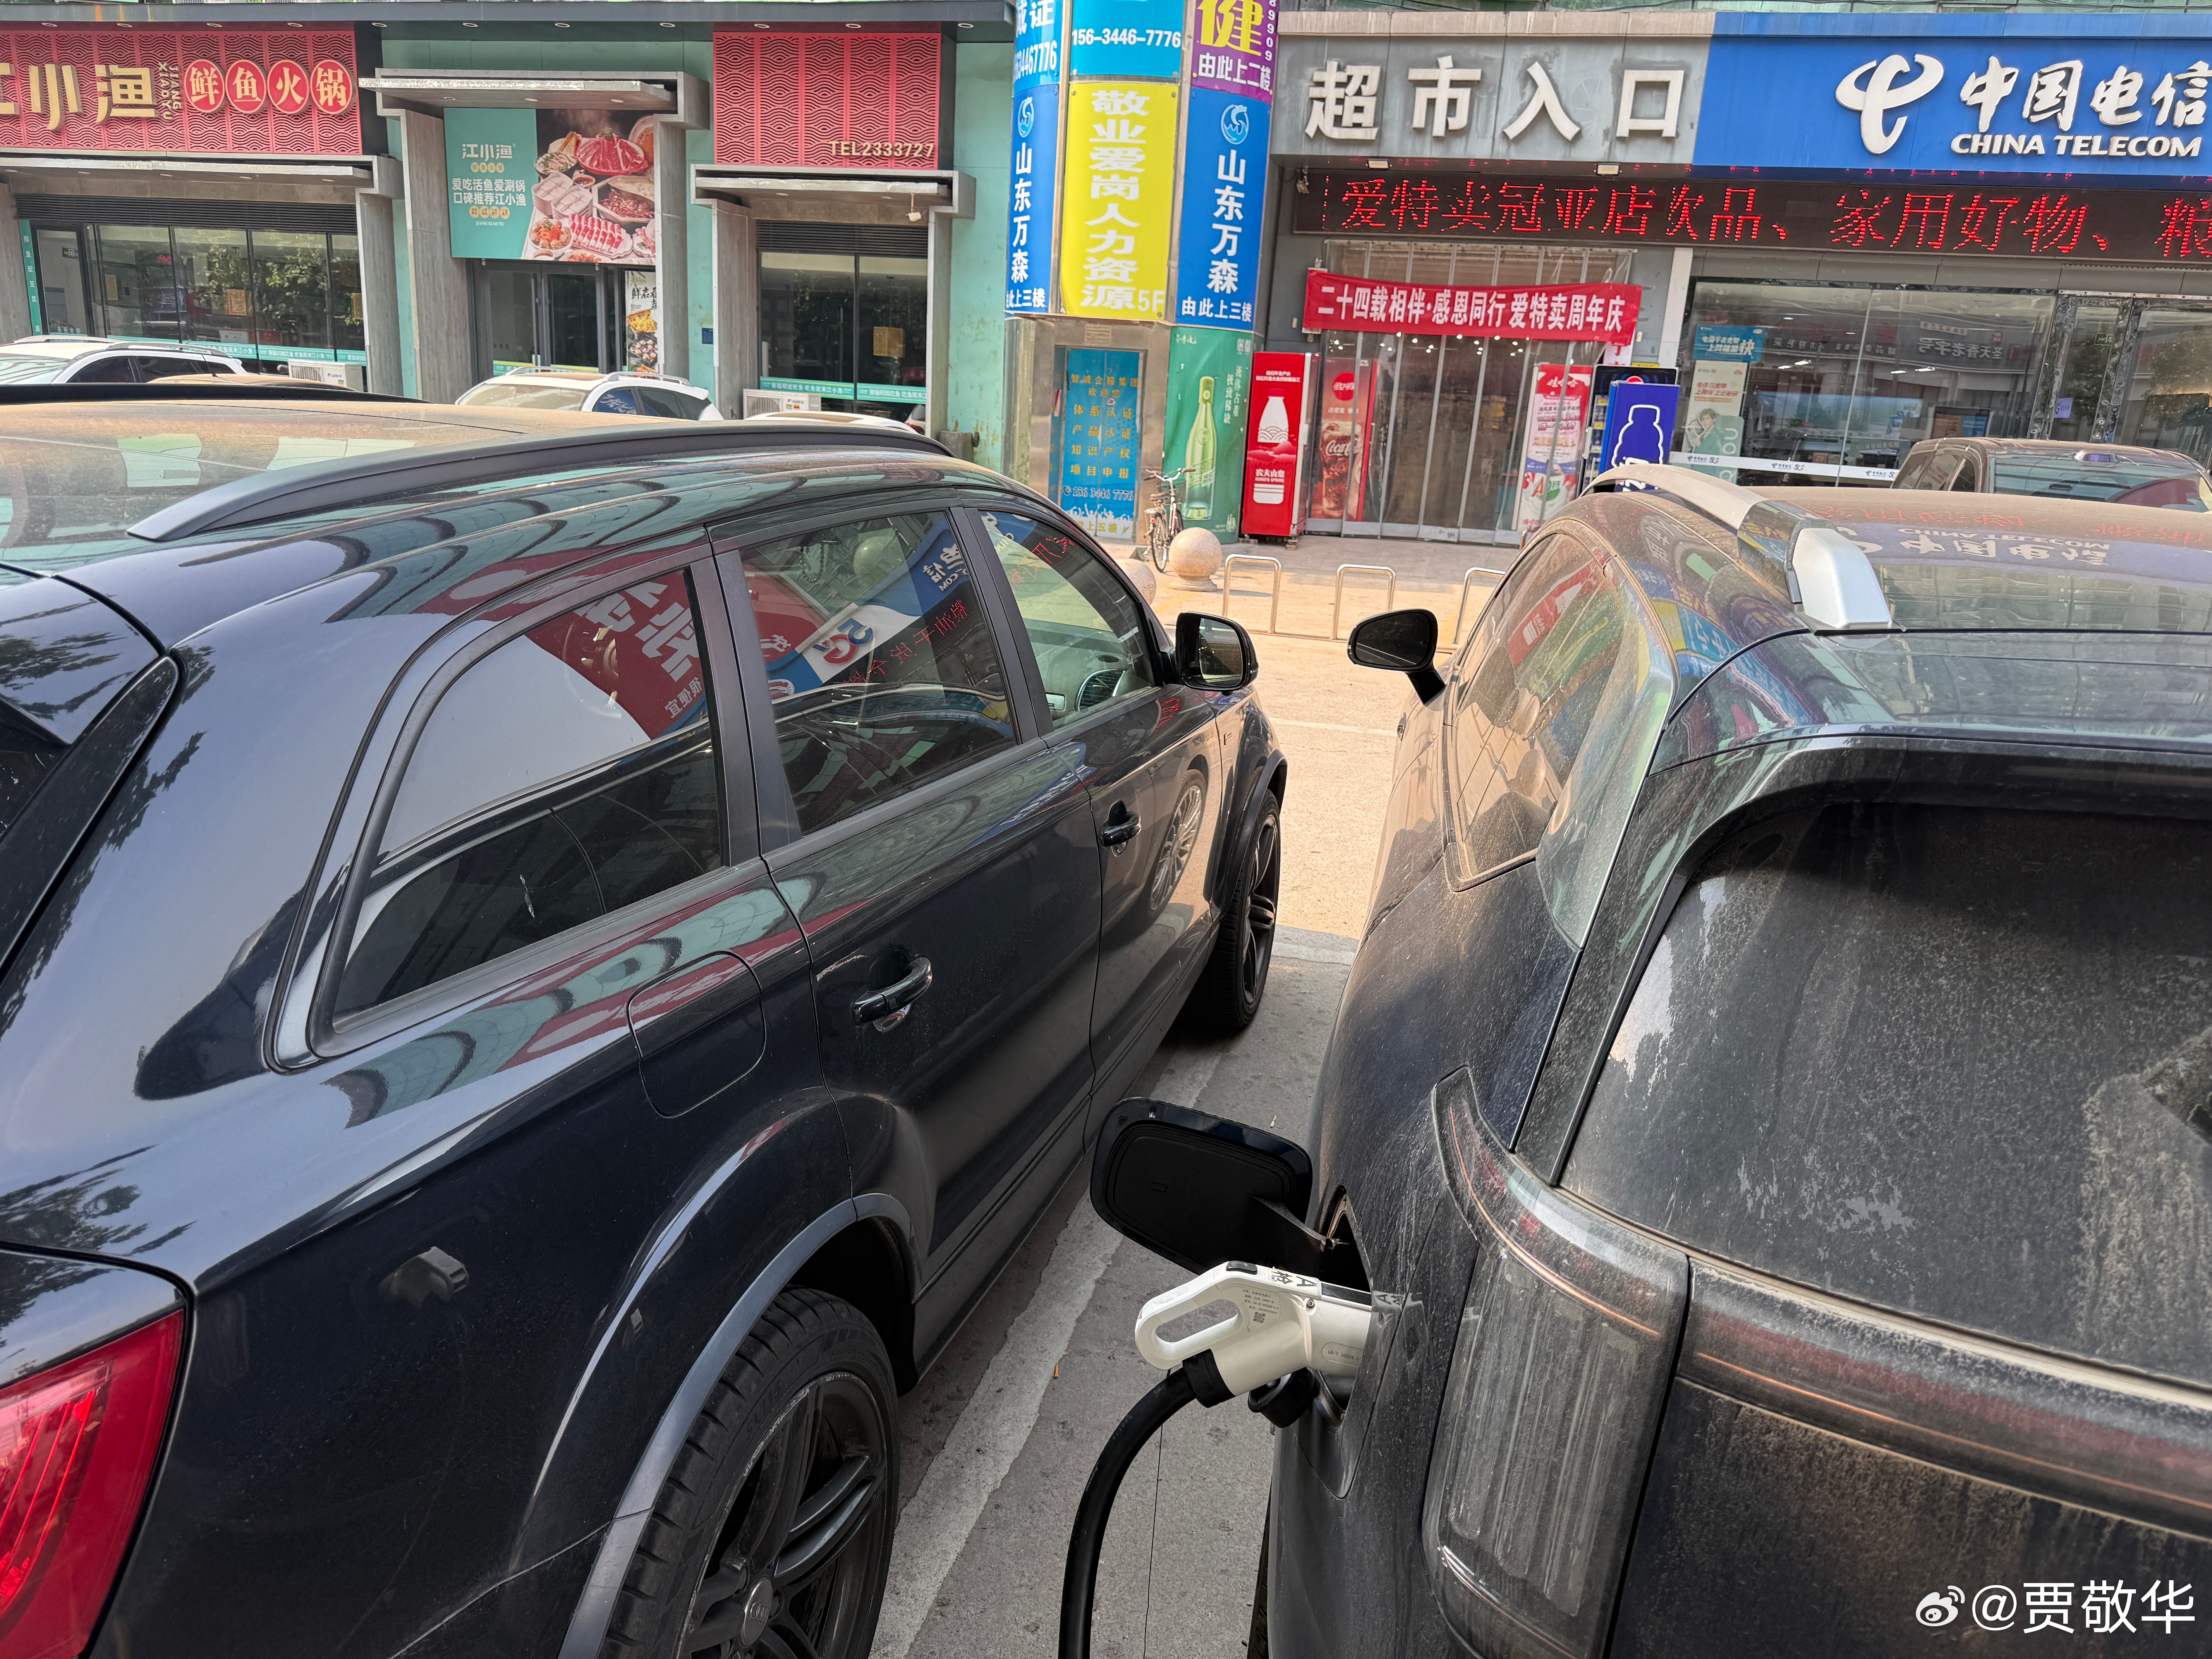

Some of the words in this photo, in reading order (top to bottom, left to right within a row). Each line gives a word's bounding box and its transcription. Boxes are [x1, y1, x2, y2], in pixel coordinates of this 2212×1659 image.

[1072, 28, 1182, 48] 156-3446-7776
[1197, 0, 1264, 57] 健
[1198, 53, 1271, 92] 由此上二楼
[189, 67, 347, 107] 鲜鱼火锅
[1960, 56, 2212, 132] 中国电信
[1304, 55, 1685, 142] 超市入口
[462, 144, 513, 161] 江小渔
[828, 140, 935, 158] TEL2333727
[1950, 134, 2046, 155] CHINA
[2054, 135, 2202, 158] TELECOM
[452, 178, 526, 192] 爱吃活鱼爱涮锅
[453, 192, 527, 206] 口碑推荐江小渔
[1080, 90, 1150, 310] 敬业爱岗人力资源
[1137, 290, 1165, 313] 5F
[1011, 142, 1033, 283] 山东万森
[1207, 149, 1246, 294] 山东万森
[1182, 296, 1252, 323] 由此上三楼
[1510, 292, 1625, 332] 爱特卖周年庆
[1074, 404, 1133, 419] 体系认证
[1072, 424, 1131, 439] 产品认证
[1072, 445, 1130, 459] 知识产权
[1070, 464, 1129, 479] 项目申报
[1255, 468, 1285, 478] 农夫山泉
[1072, 486, 1088, 498] 156
[1089, 487, 1111, 500] 3446
[1113, 489, 1134, 501] 7776
